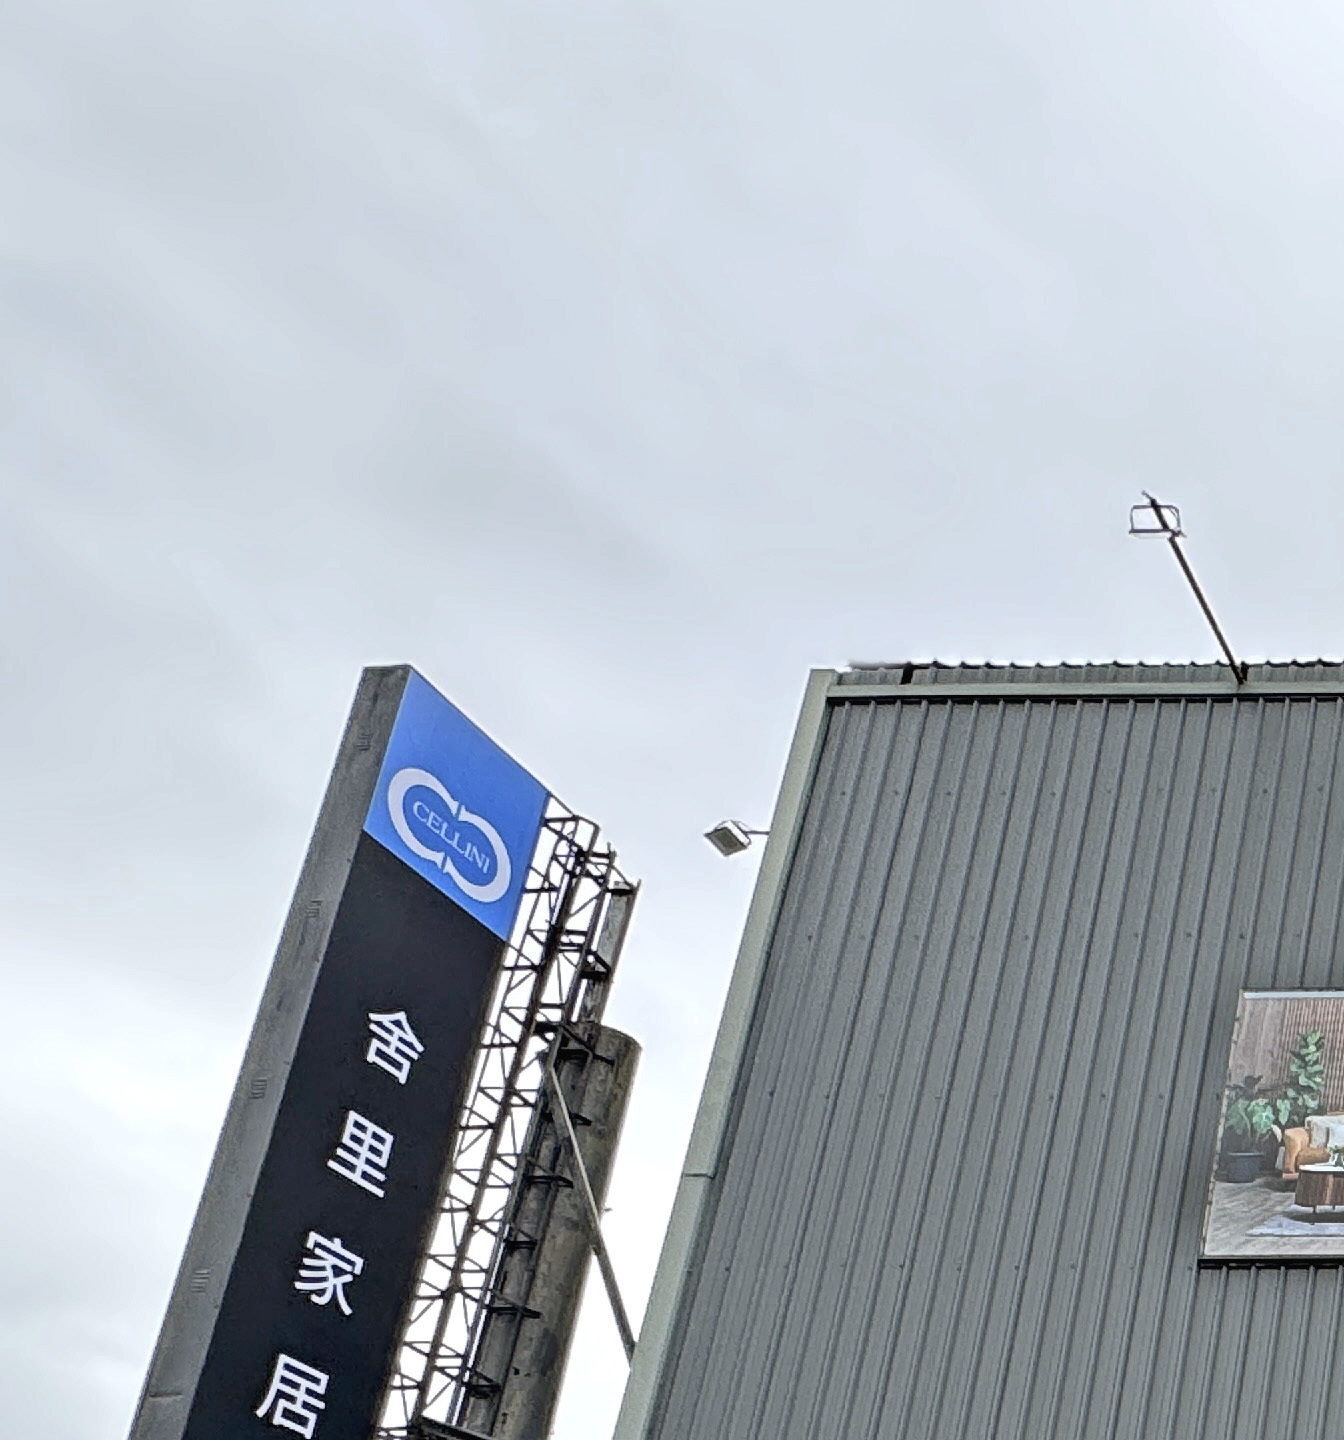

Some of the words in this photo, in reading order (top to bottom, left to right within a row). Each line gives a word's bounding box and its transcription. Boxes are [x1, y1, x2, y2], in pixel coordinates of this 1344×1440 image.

[413, 801, 490, 873] CELLINI
[254, 1008, 427, 1440] 舍里家居
